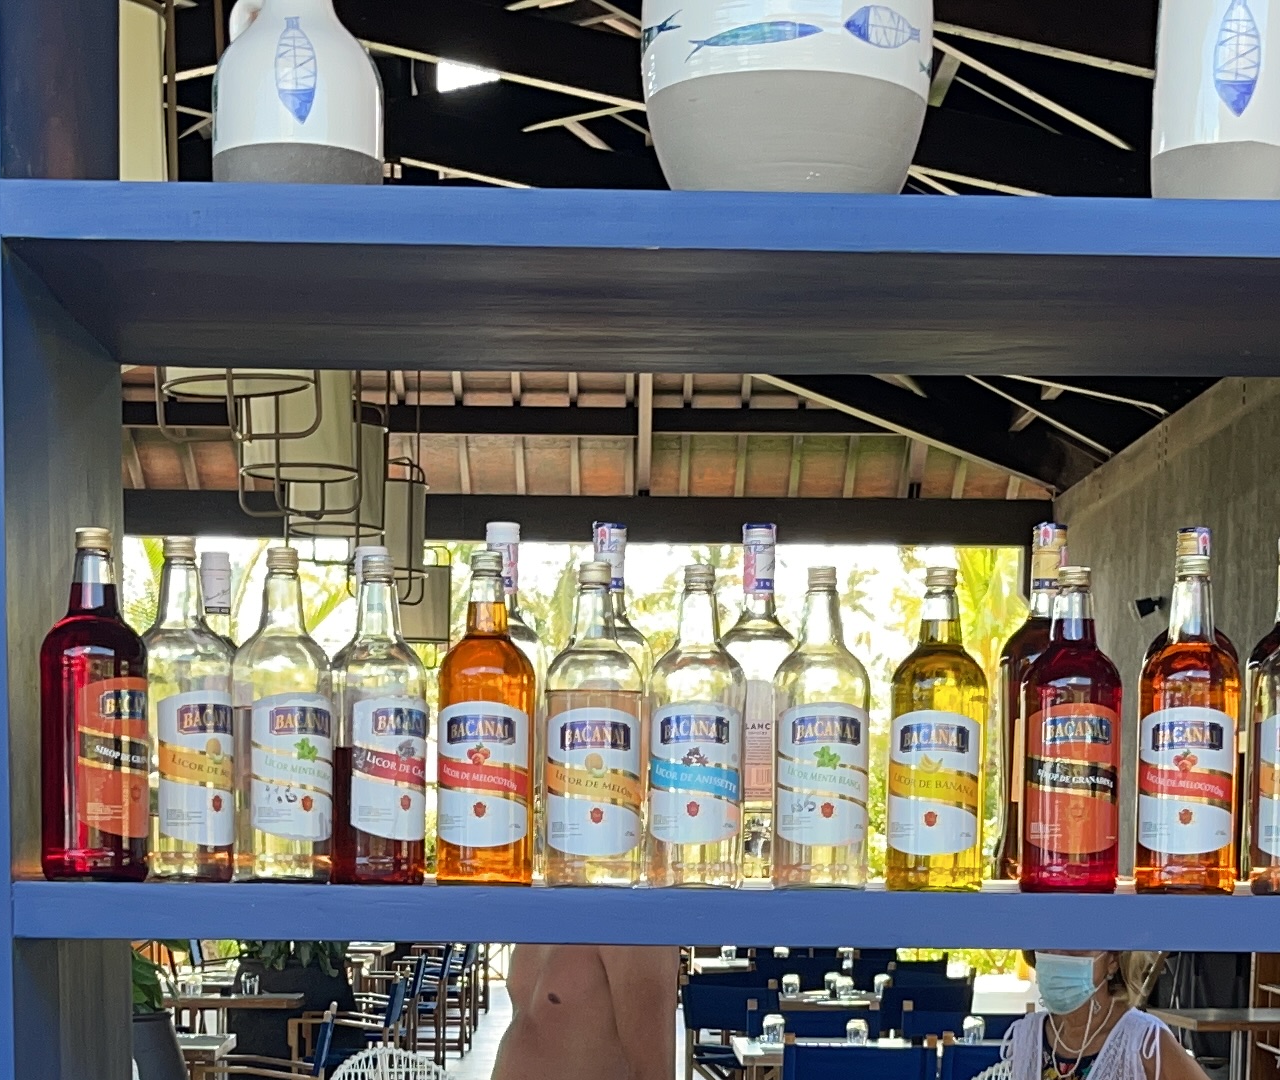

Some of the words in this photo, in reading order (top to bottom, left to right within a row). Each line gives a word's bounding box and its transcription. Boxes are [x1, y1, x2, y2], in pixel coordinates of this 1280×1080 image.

[451, 716, 509, 739] BACANAL
[565, 723, 625, 745] BACANAL
[664, 717, 727, 740] BACANAL
[795, 718, 858, 740] BACANAL
[903, 726, 966, 750] BACANAL
[1047, 719, 1109, 742] BACANAL
[172, 754, 205, 772] LICOR
[207, 764, 219, 773] DE
[265, 756, 288, 771] LICOR
[291, 762, 315, 776] MENTA
[367, 753, 396, 771] LICOR
[399, 763, 411, 773] DE
[442, 765, 464, 779] LICOR
[465, 771, 472, 780] DE
[656, 764, 677, 780] LICOR
[679, 772, 693, 783] DE
[555, 769, 582, 785] LICOR
[585, 778, 599, 788] DE
[602, 779, 634, 798] MELÓN
[787, 765, 808, 779] LICOR
[809, 771, 837, 784] MENTA
[894, 771, 917, 786] LICOR
[918, 778, 933, 789] DE
[934, 780, 974, 796] BANANA
